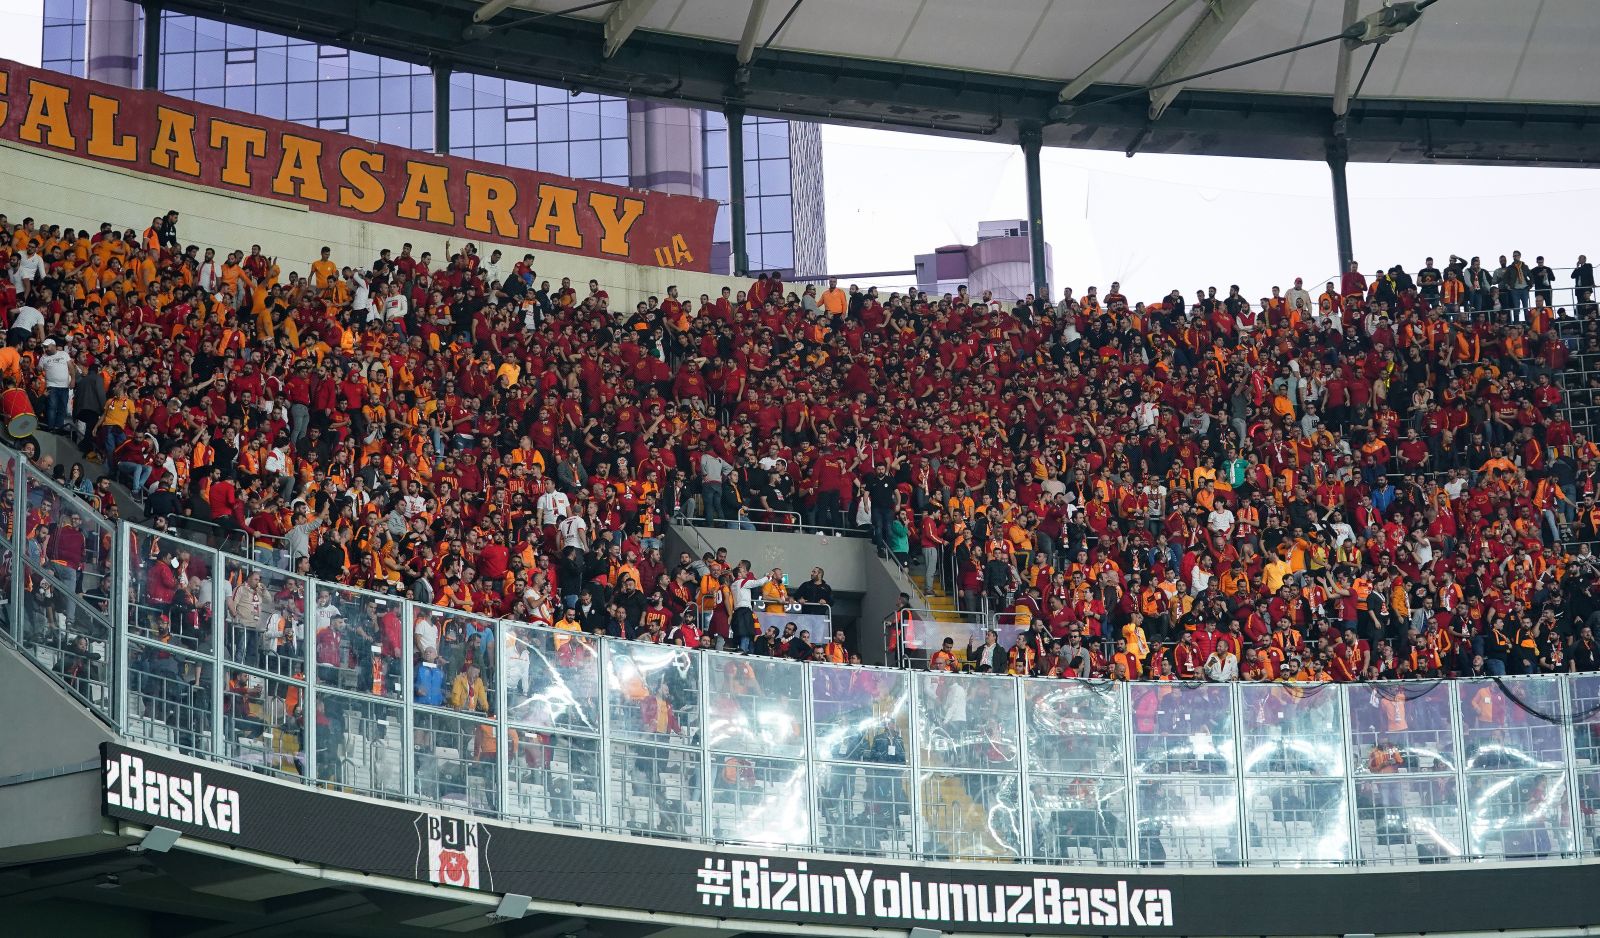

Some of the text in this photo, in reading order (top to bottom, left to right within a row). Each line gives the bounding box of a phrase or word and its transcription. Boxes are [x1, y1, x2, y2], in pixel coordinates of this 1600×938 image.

[0, 71, 646, 257] ALATASARAY
[566, 520, 574, 535] 7
[429, 816, 477, 848] BJK
[696, 857, 1174, 927] #BizimYolumuzBaska
